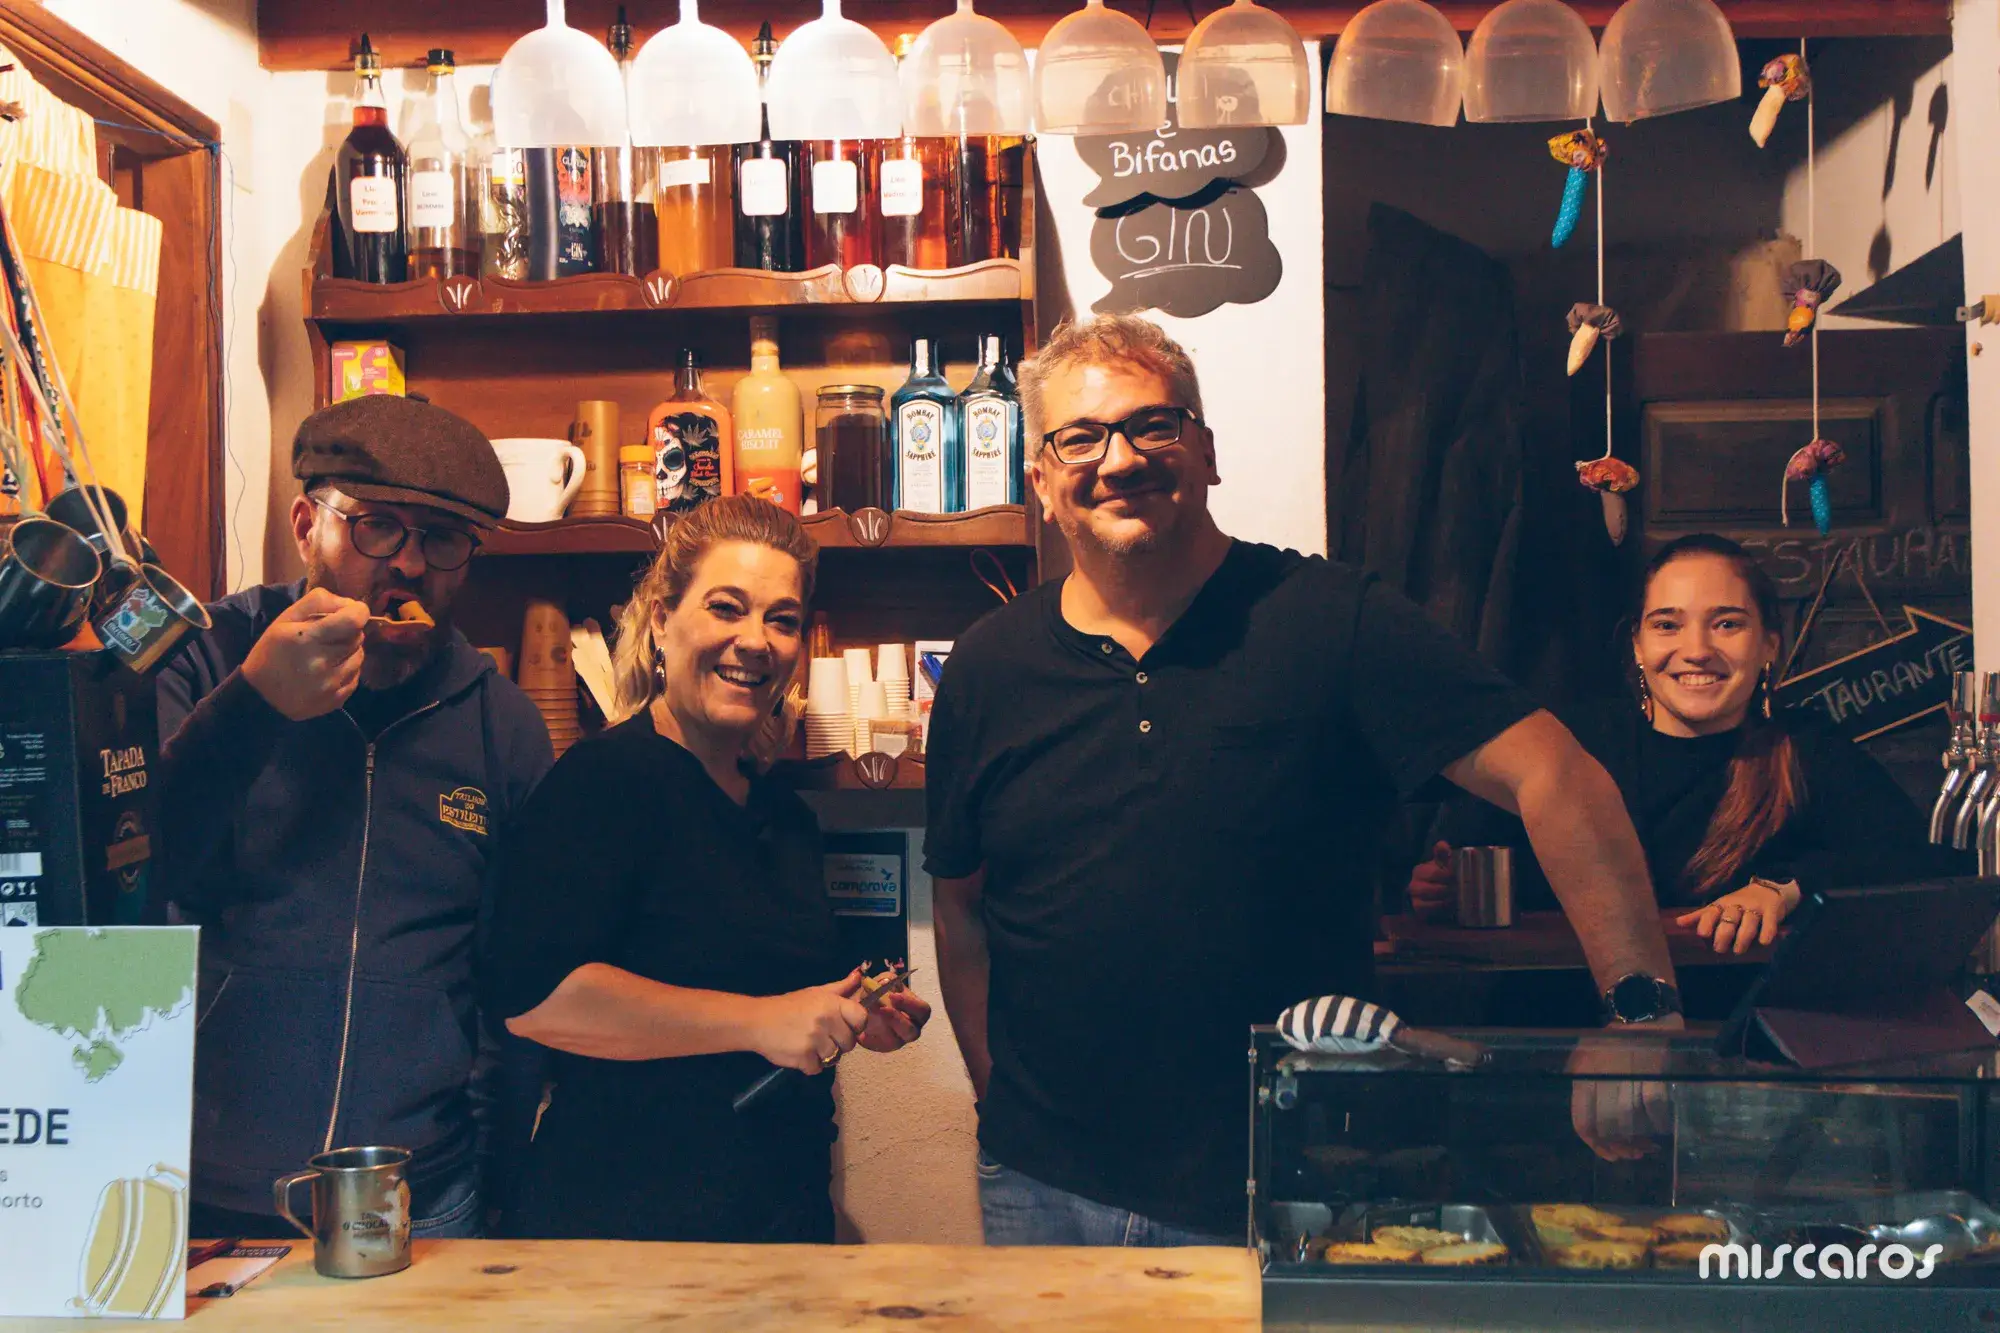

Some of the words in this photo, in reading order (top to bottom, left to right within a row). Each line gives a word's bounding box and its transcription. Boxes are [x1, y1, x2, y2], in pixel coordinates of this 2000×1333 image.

[1108, 140, 1237, 177] Bifanas
[1116, 207, 1233, 265] GIN
[906, 409, 934, 421] BOMBAY
[972, 406, 1000, 419] BOMBAY
[737, 428, 784, 440] CARAMEL
[741, 439, 779, 451] BISCUIT
[972, 446, 1002, 459] SAPPHIRE
[905, 447, 937, 461] SAPPHIRE
[1788, 634, 1972, 723] TAURANTE
[101, 747, 145, 777] TAPADA
[110, 770, 147, 798] FRANCO
[0, 1192, 43, 1209] orto
